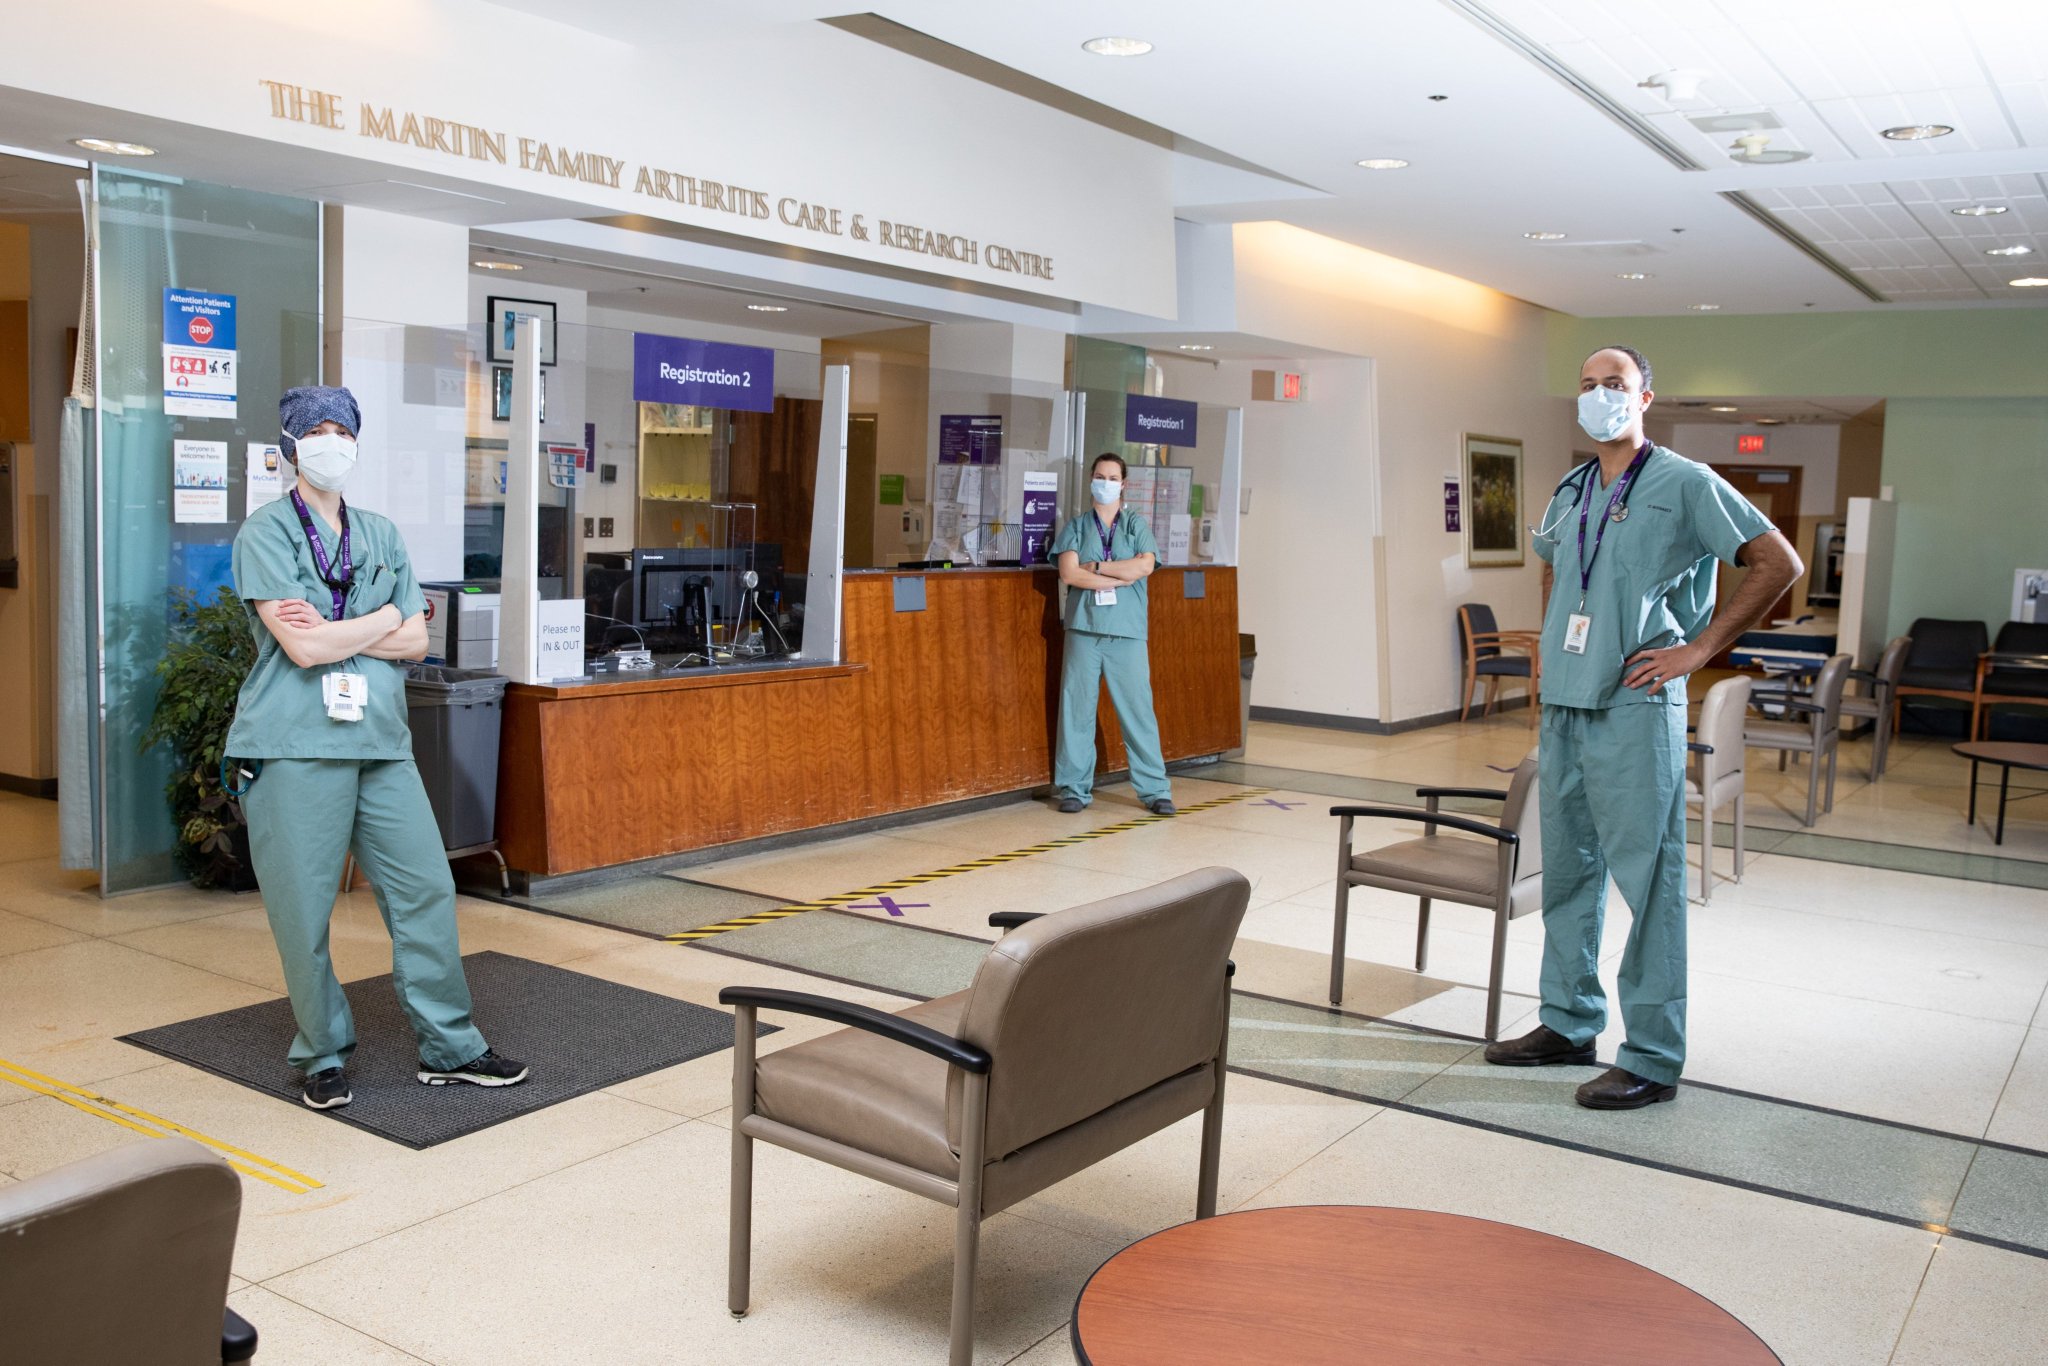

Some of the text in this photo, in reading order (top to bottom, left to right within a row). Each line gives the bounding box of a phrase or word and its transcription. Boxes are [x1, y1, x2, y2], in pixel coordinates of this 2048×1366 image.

[259, 79, 1054, 281] THE MARTIN FAMILY ARTHRITIS CARE & RESEARCH CENTRE
[170, 294, 231, 308] Attention Patients
[181, 305, 221, 316] and Visitors
[191, 325, 212, 335] STOP
[660, 362, 751, 387] Registration 2
[1138, 413, 1184, 430] Registration 1
[184, 444, 210, 453] Everyone
[543, 624, 581, 634] Please no
[543, 640, 580, 651] IN & OUT
